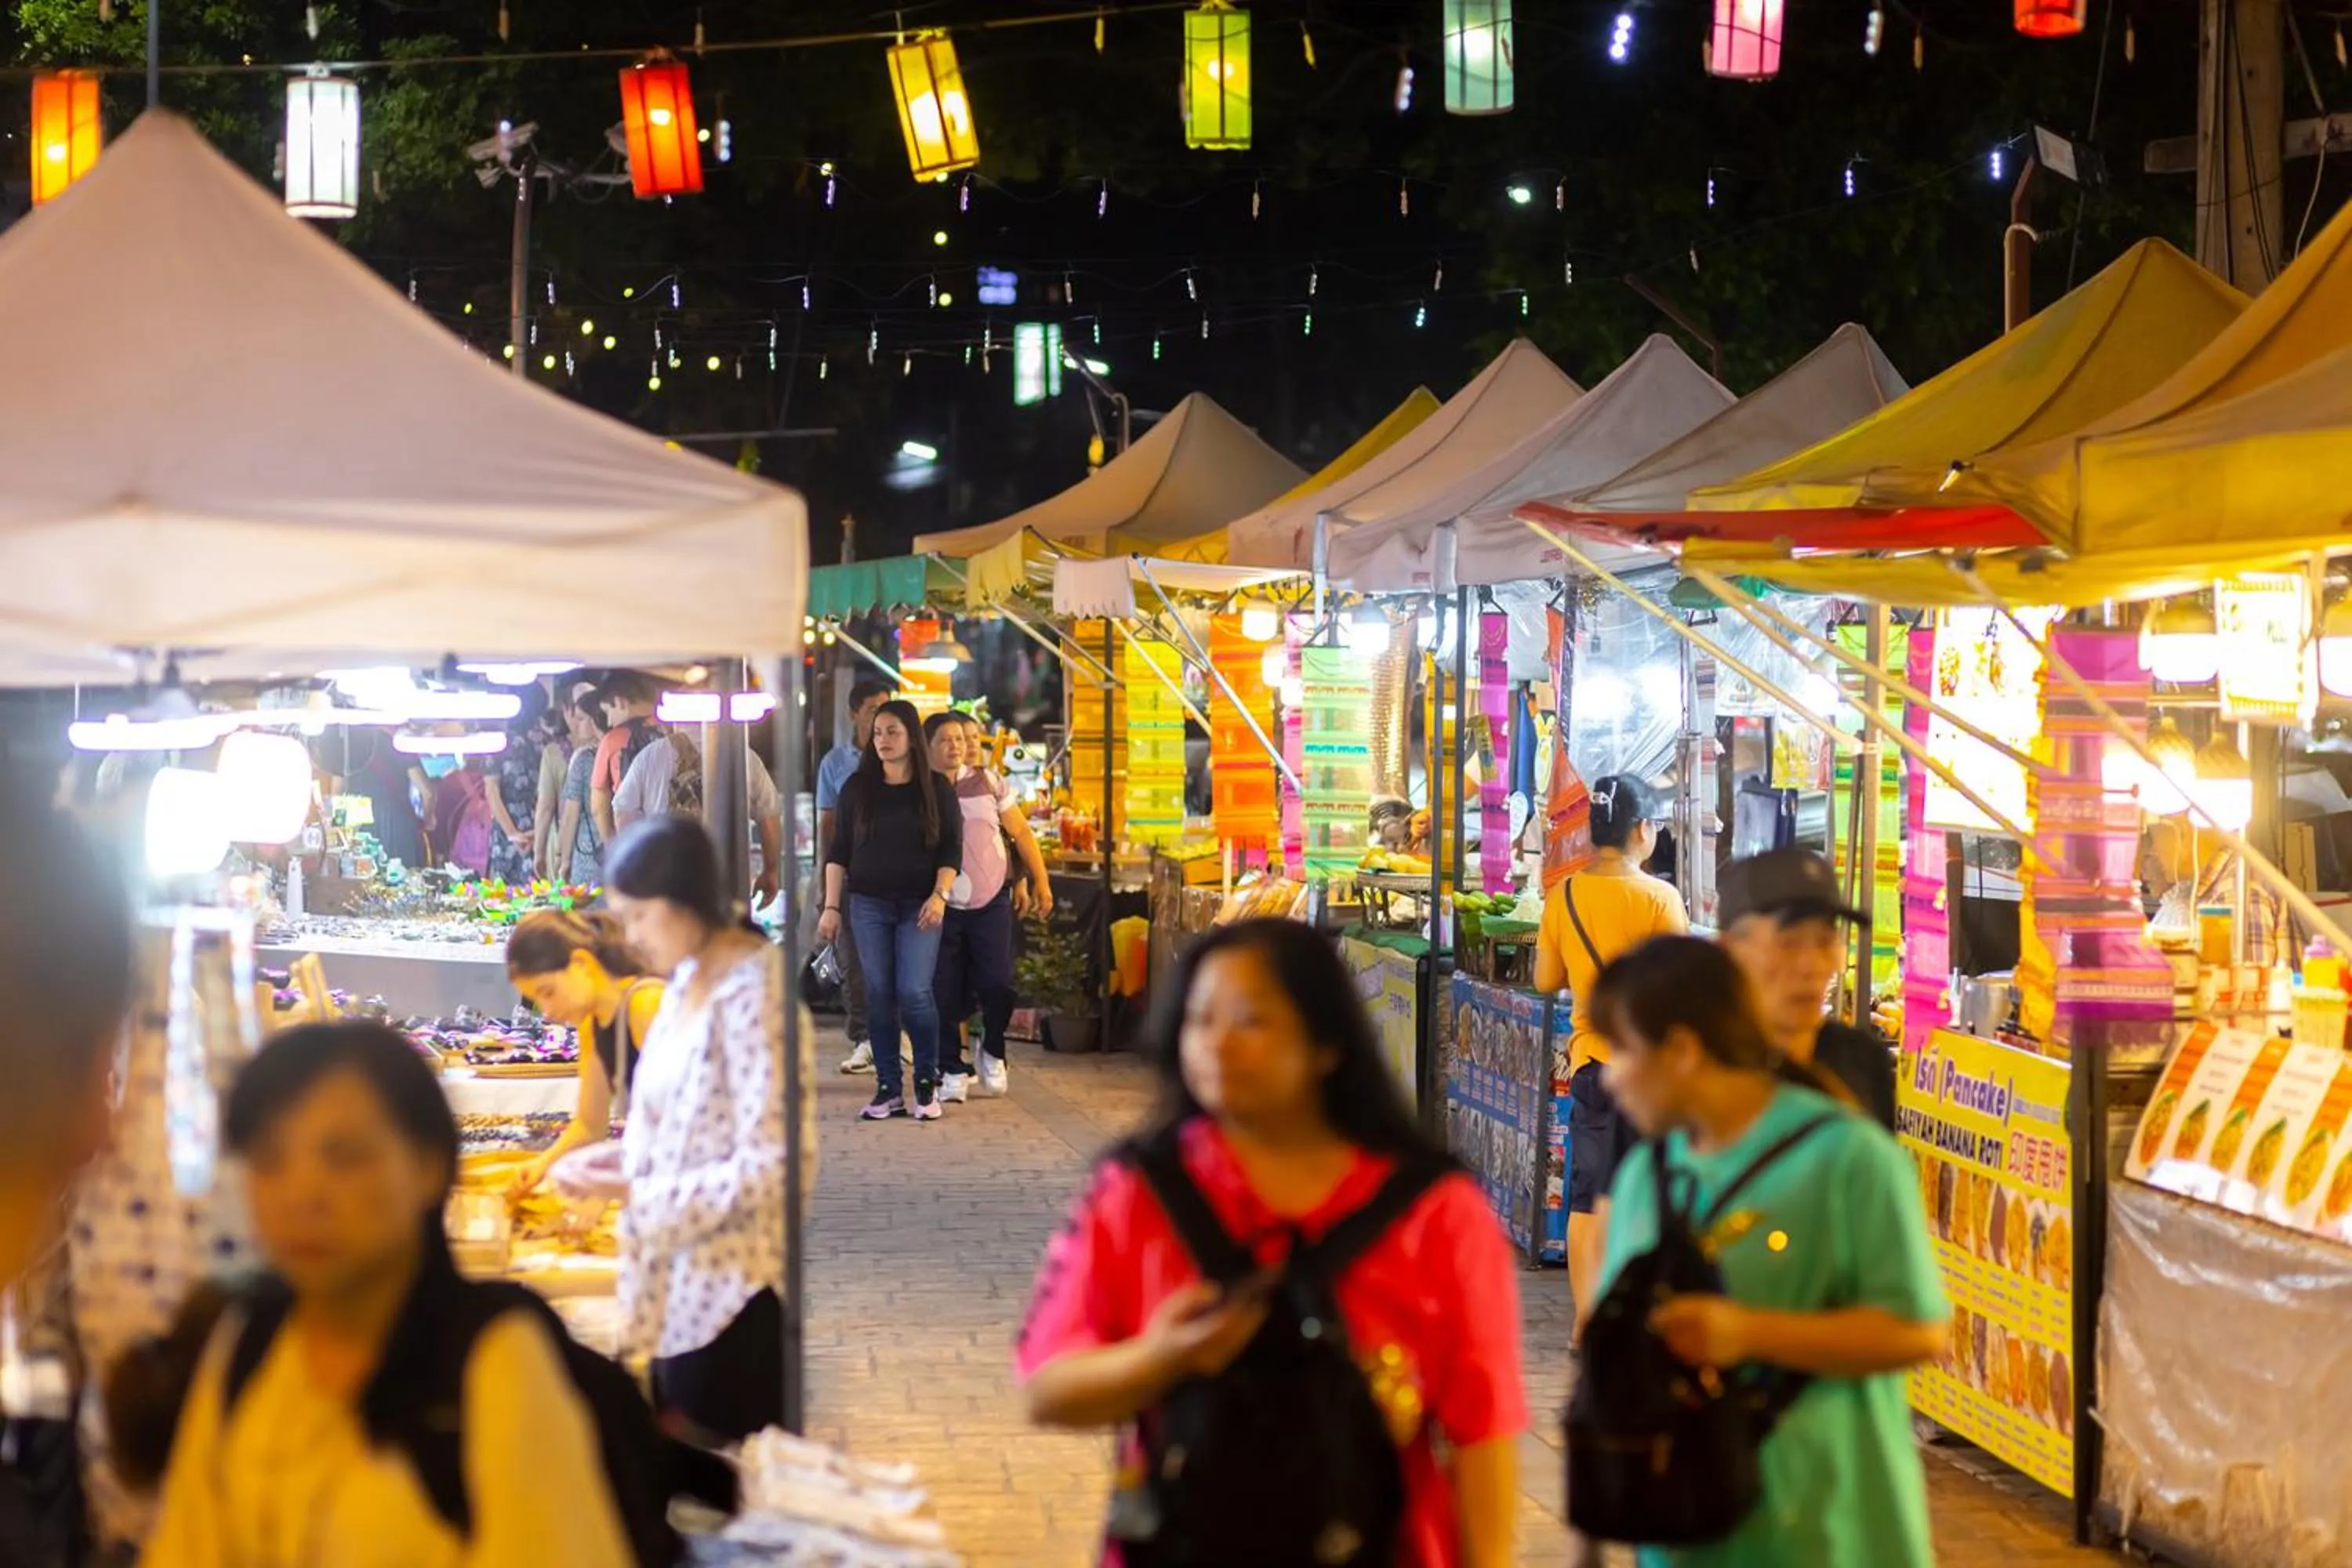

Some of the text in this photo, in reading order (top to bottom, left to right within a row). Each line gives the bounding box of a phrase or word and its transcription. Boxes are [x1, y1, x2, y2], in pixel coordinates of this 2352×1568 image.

[1939, 1058, 2013, 1127] (Pancake)
[1896, 1105, 2003, 1170] SAFIYAH BANANA ROTI
